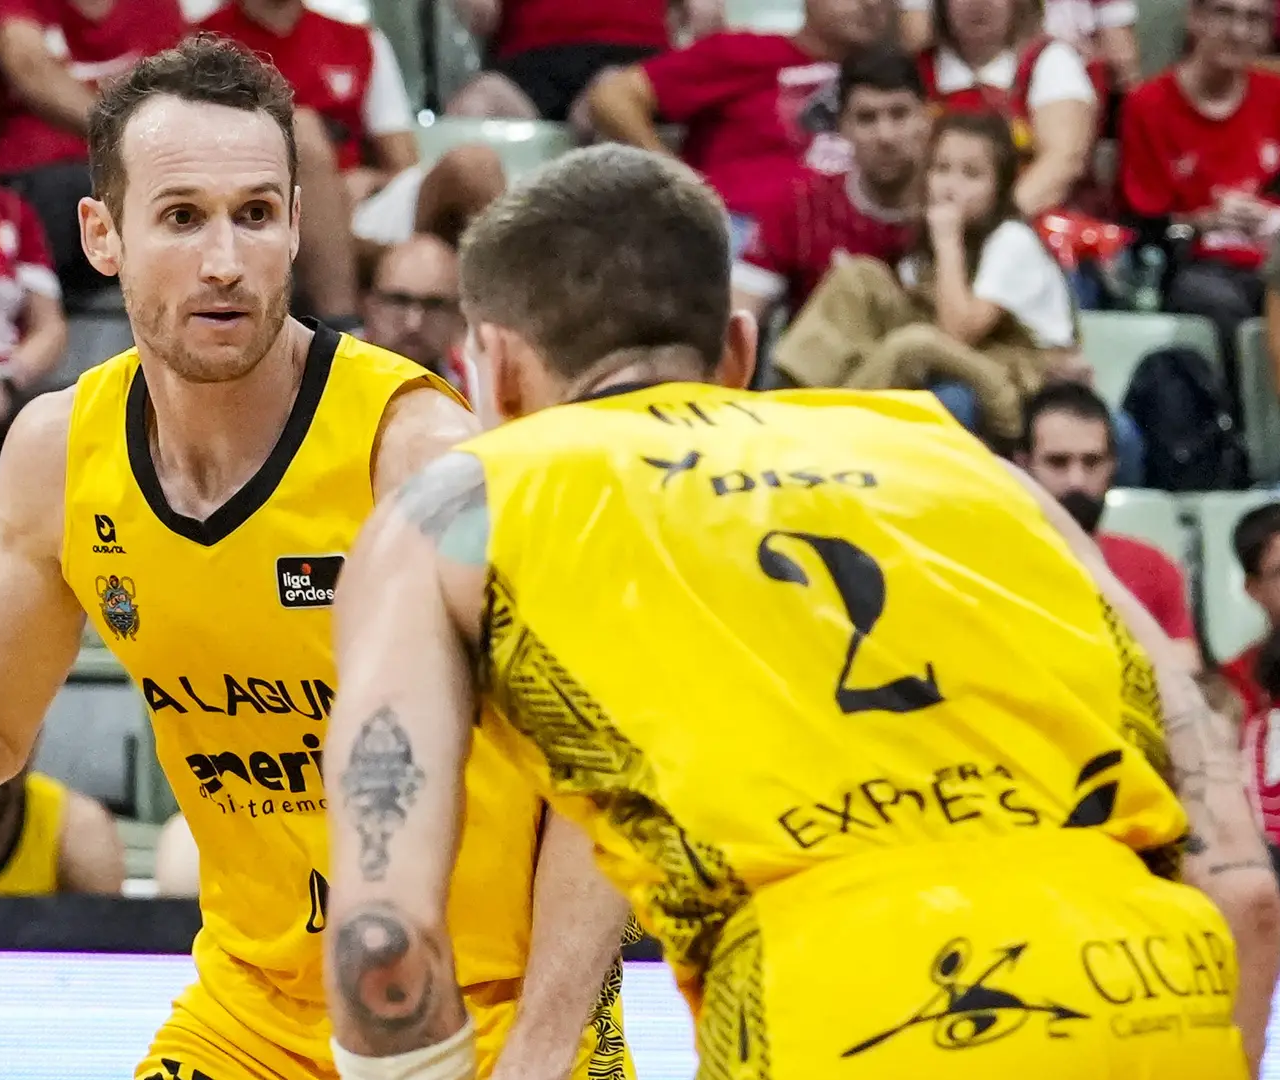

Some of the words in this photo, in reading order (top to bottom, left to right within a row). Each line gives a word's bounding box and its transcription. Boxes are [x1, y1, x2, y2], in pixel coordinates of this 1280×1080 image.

[282, 571, 312, 589] liga
[285, 586, 338, 601] endes
[757, 530, 946, 715] 2
[178, 673, 337, 721] LAGUN
